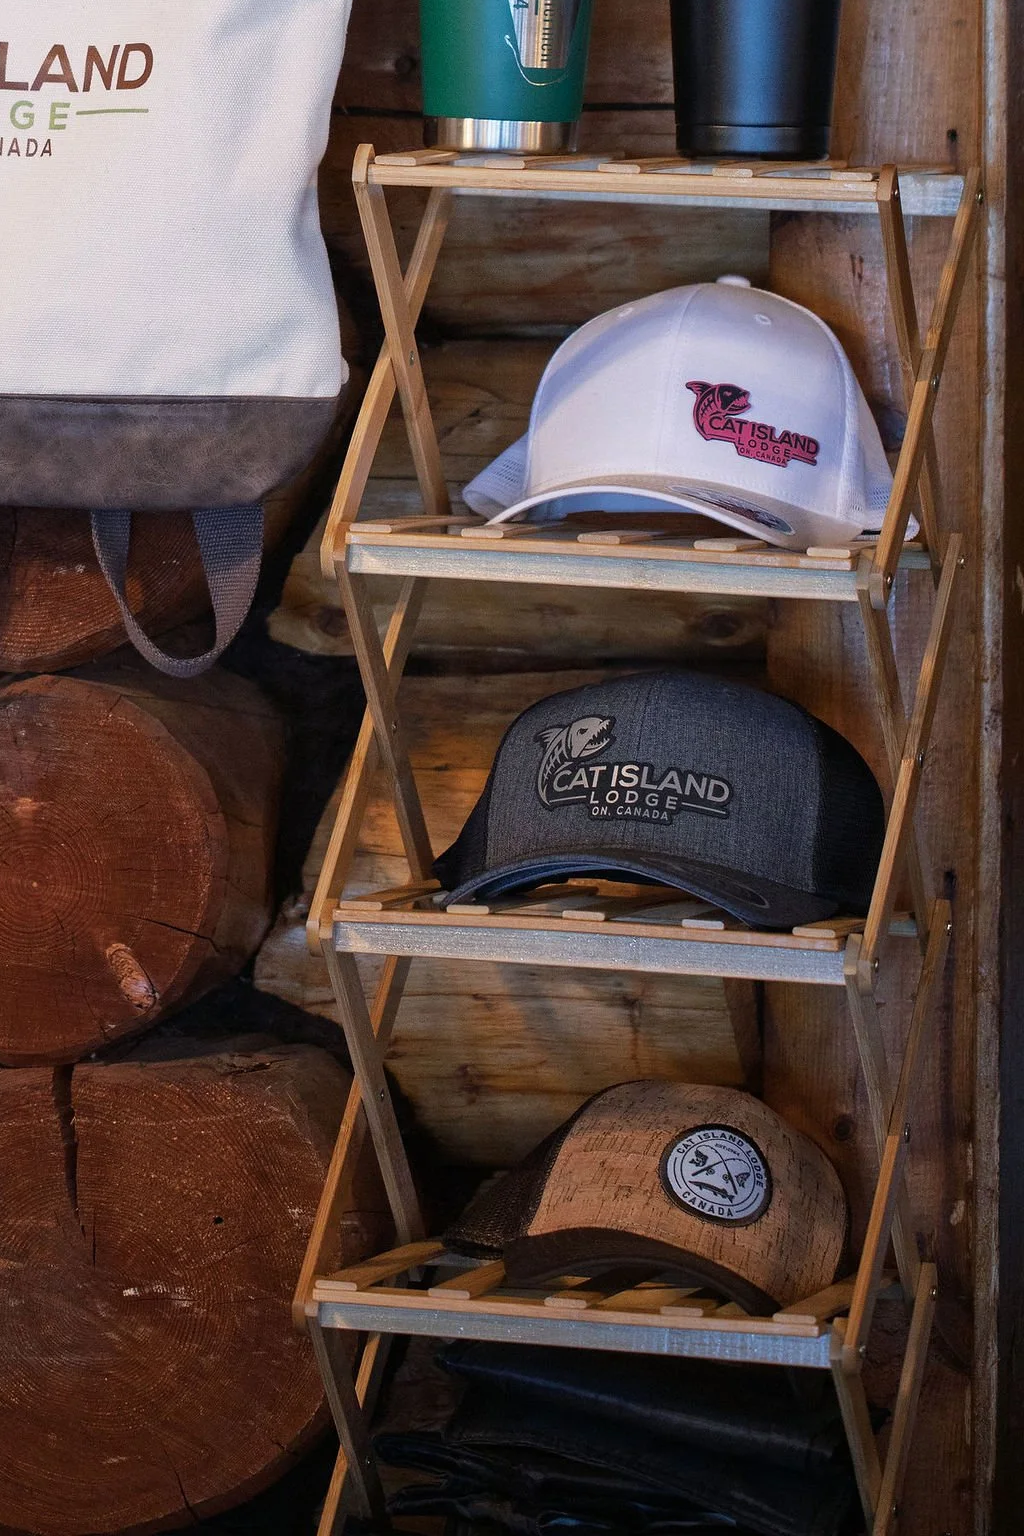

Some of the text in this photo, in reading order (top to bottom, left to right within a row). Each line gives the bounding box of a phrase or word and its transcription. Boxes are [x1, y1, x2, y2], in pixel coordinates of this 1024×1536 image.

[708, 415, 820, 456] CAT ISLAND
[737, 436, 792, 458] LODGE
[756, 450, 787, 465] CANADA
[552, 764, 730, 803] CAT ISLAND
[589, 790, 678, 810] LODGE
[616, 805, 669, 821] CANADA
[677, 1138, 695, 1154] CAT
[697, 1131, 744, 1148] ISLAND
[746, 1149, 764, 1188] LODGE
[682, 1190, 734, 1217] CANADA
